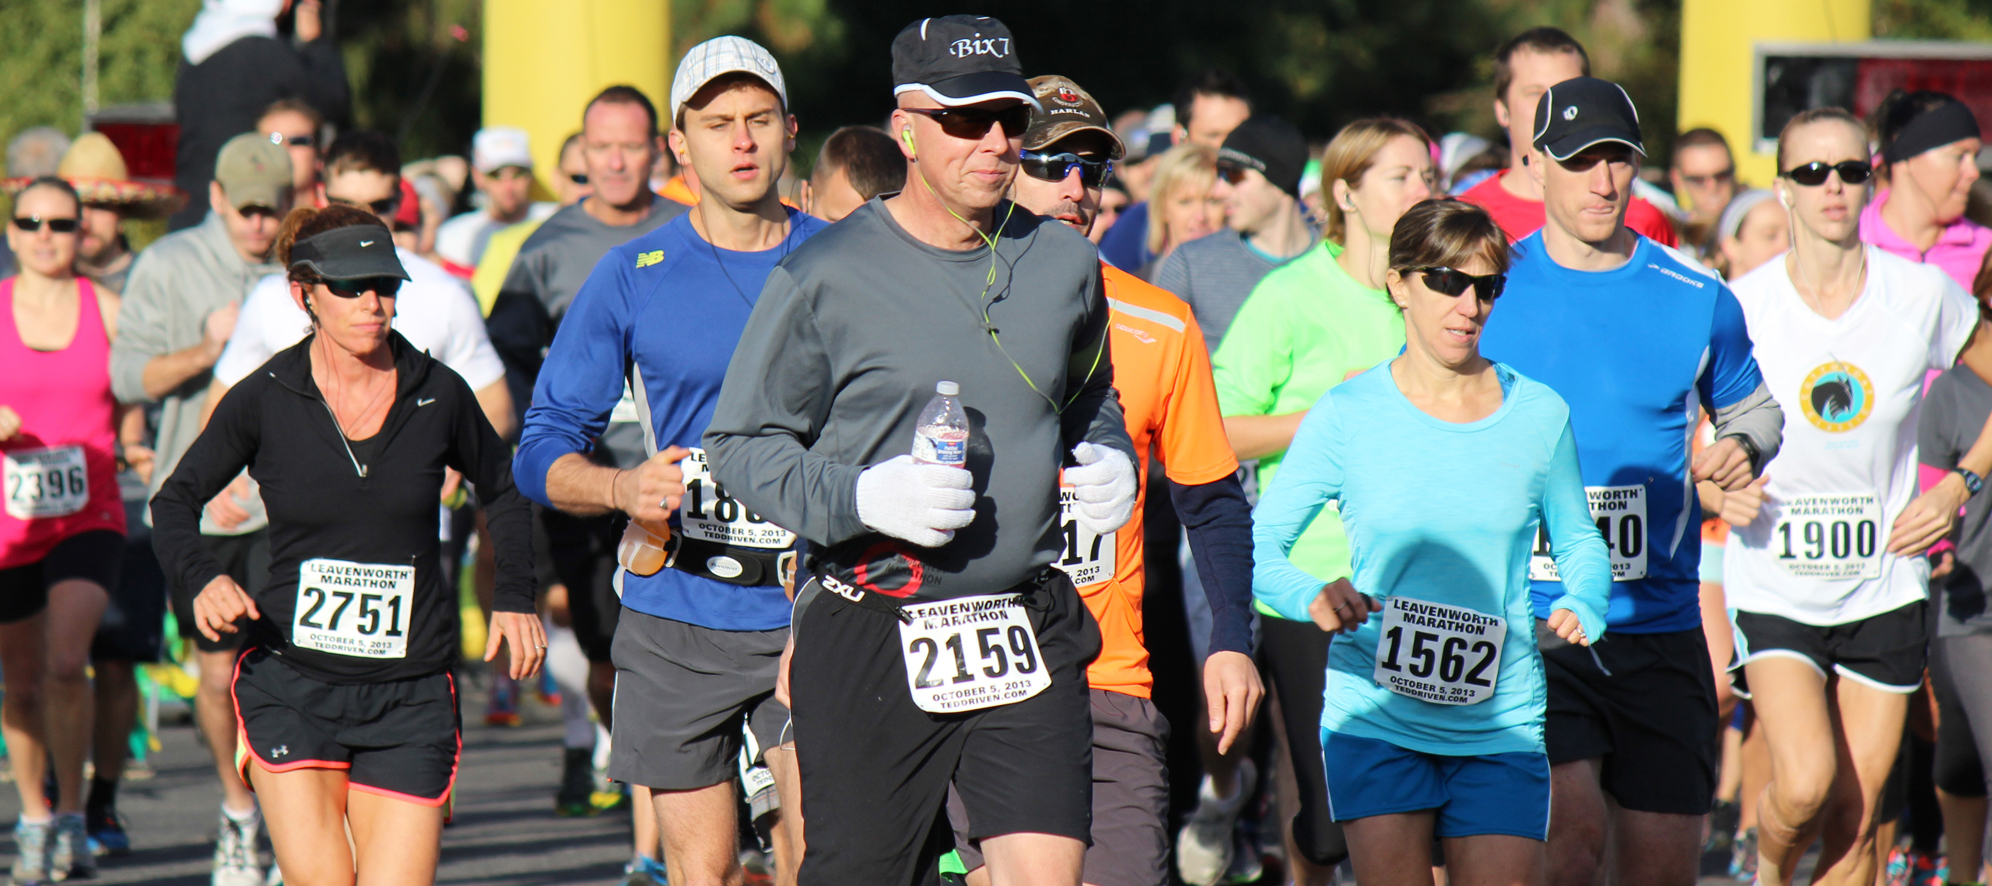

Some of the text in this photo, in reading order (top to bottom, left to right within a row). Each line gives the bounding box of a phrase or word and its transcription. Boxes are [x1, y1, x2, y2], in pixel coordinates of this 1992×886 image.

[10, 466, 84, 500] 2396
[686, 478, 767, 524] 18
[1790, 506, 1863, 516] MARATHON
[699, 522, 786, 537] OCTOBER 5, 2013
[704, 530, 781, 544] TEDDRIVEN.COM
[1778, 520, 1876, 559] 1900
[310, 563, 408, 579] LEAVENWORTH
[1076, 565, 1100, 577] 2013
[1611, 562, 1631, 571] 013
[320, 575, 397, 589] MARATHON
[822, 574, 865, 603] 2XU
[299, 587, 402, 637] 2751
[908, 598, 1015, 620] LEAVENWORTH
[1393, 598, 1499, 627] LEAVENWORTH
[924, 610, 1009, 631] MARATHON
[1403, 612, 1486, 635] MARATHON
[310, 633, 392, 649] OCTOBER 5, 2013
[314, 641, 386, 655] TEDDRIVEN.COM
[909, 625, 1038, 690] 2159
[1381, 625, 1498, 688] 1562
[932, 679, 1032, 702] OCTOBER 5, 2013
[1390, 675, 1475, 698] OCTOBER 5, 2013
[1394, 684, 1468, 704] TEDDRIVEN.COM
[940, 689, 1028, 709] TEDDRIVEN.COM
